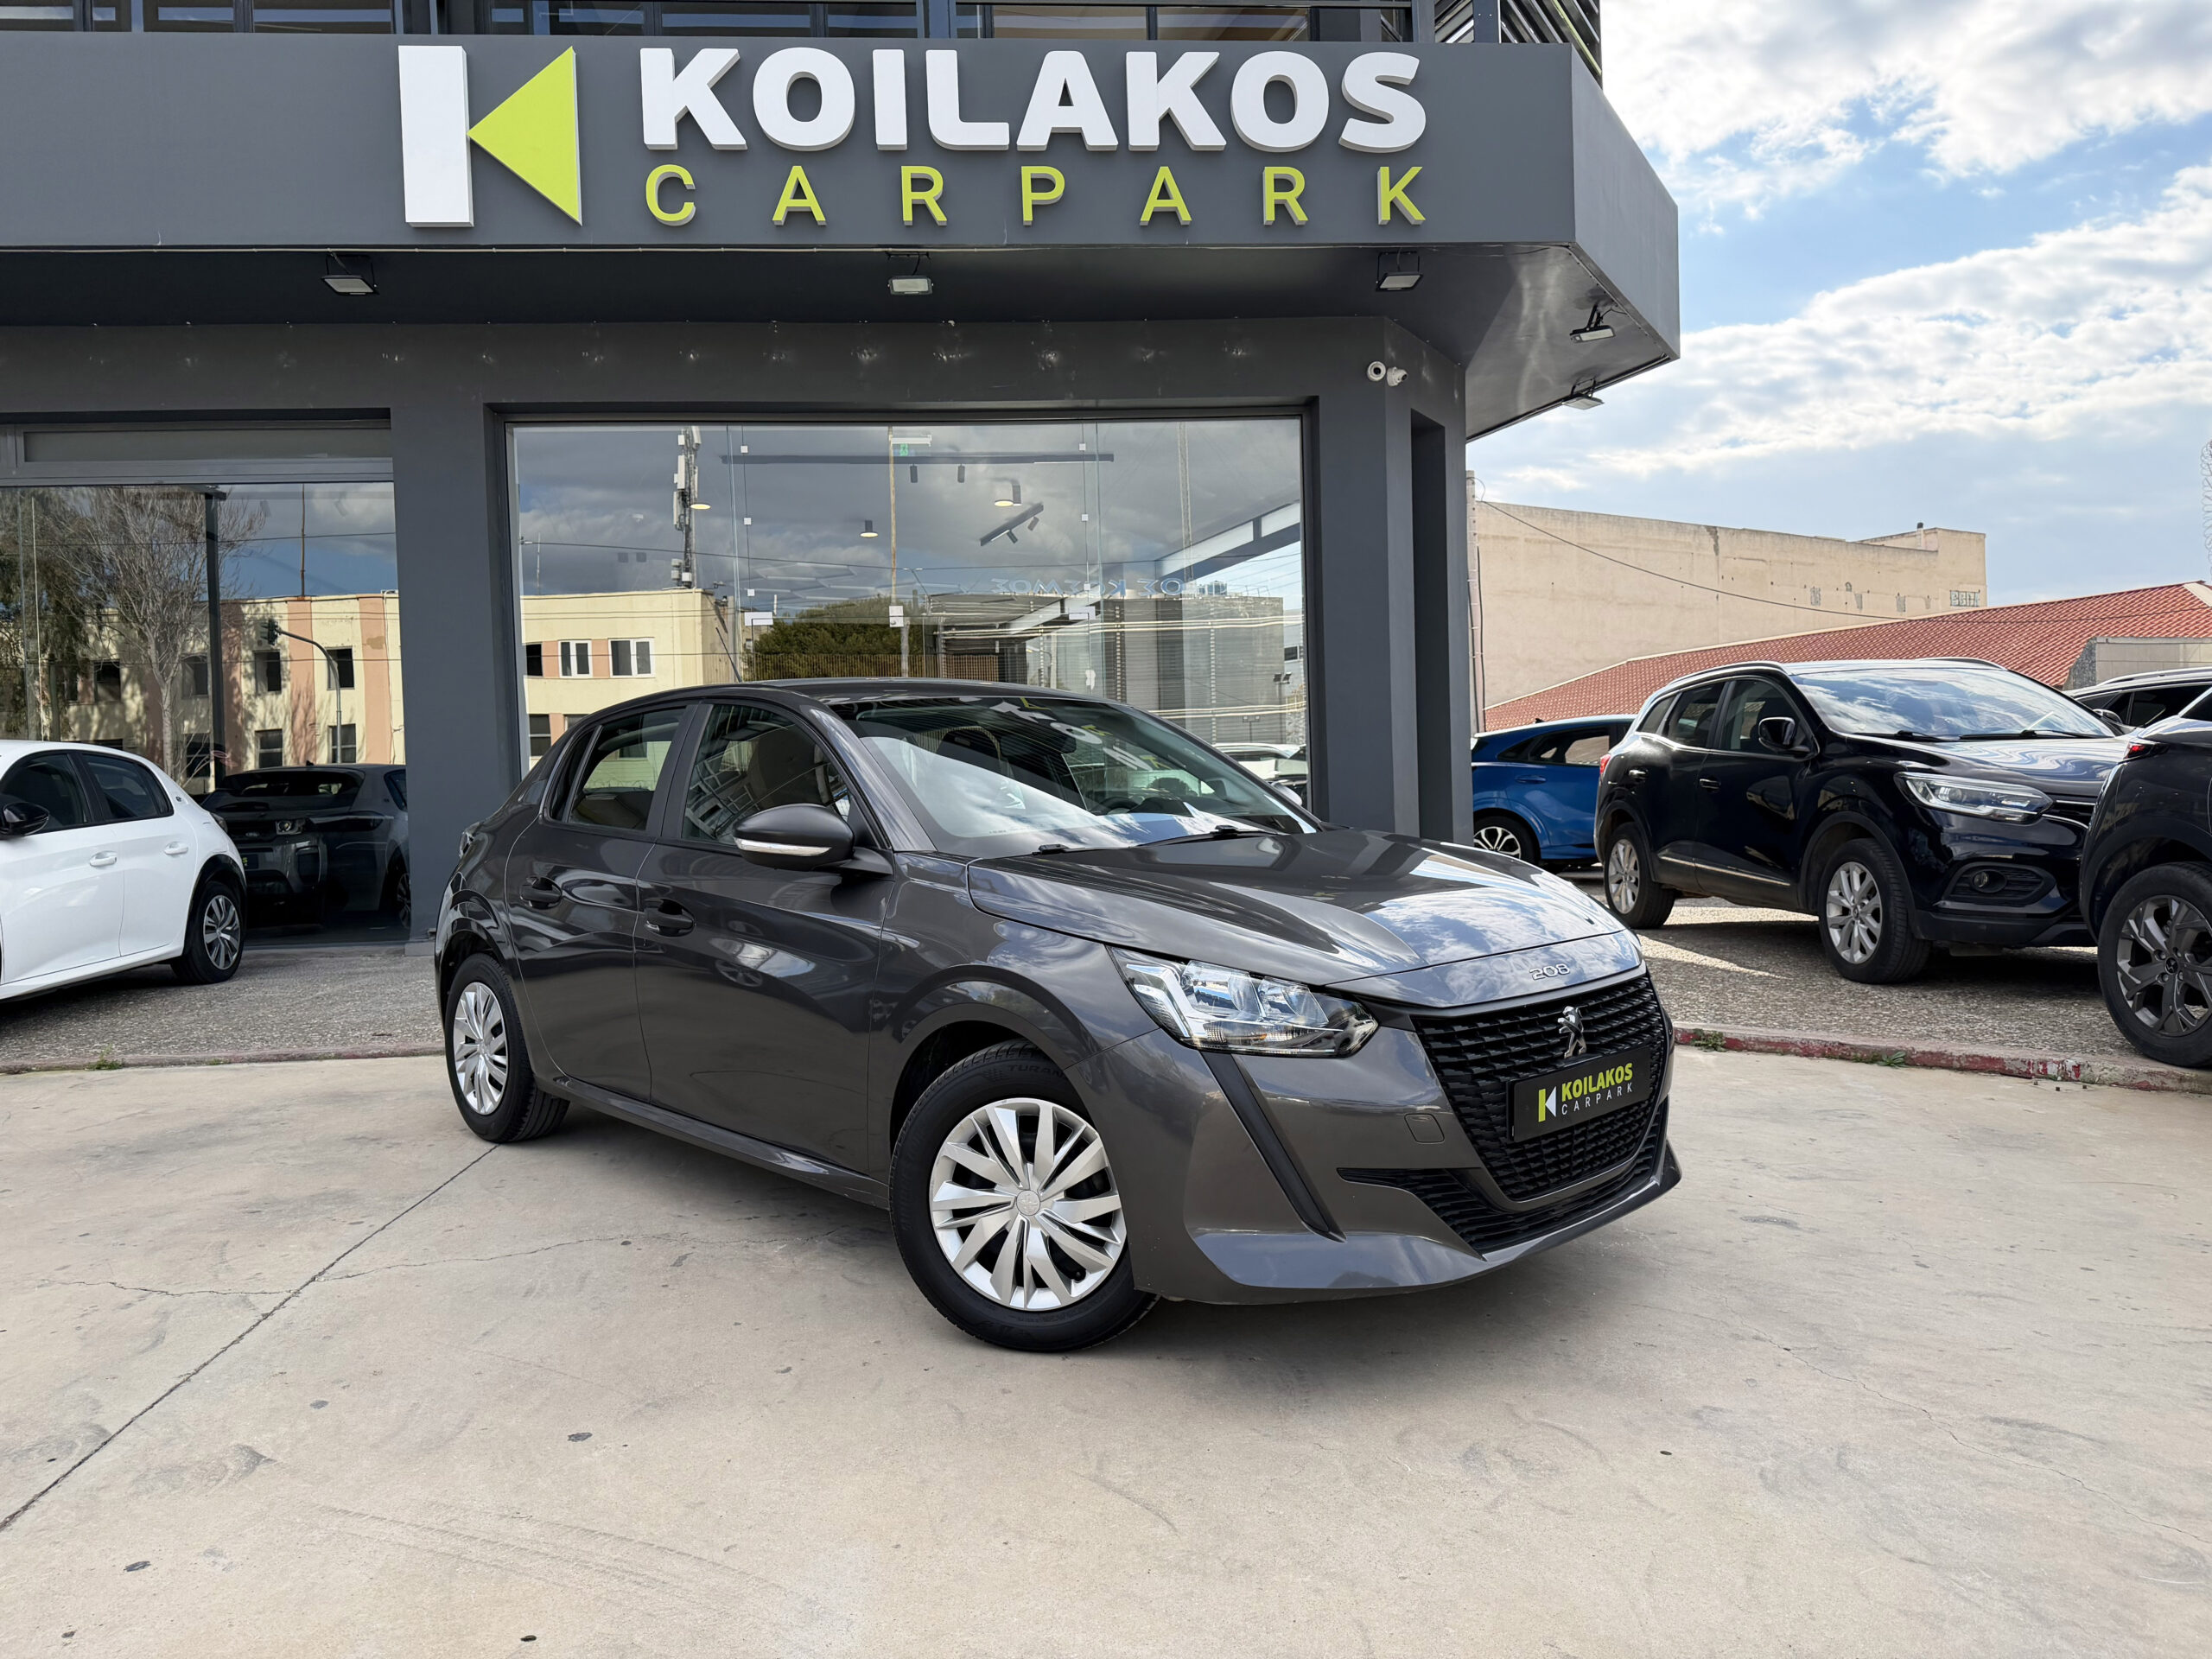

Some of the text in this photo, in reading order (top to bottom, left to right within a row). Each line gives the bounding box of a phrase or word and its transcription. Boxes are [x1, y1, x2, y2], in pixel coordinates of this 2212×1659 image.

[640, 47, 1427, 153] KOILAKOS
[645, 164, 1426, 226] CARPARK
[1529, 963, 1570, 981] 208
[1561, 1063, 1633, 1102] KOILAKOS
[1561, 1083, 1633, 1116] CARPARK
